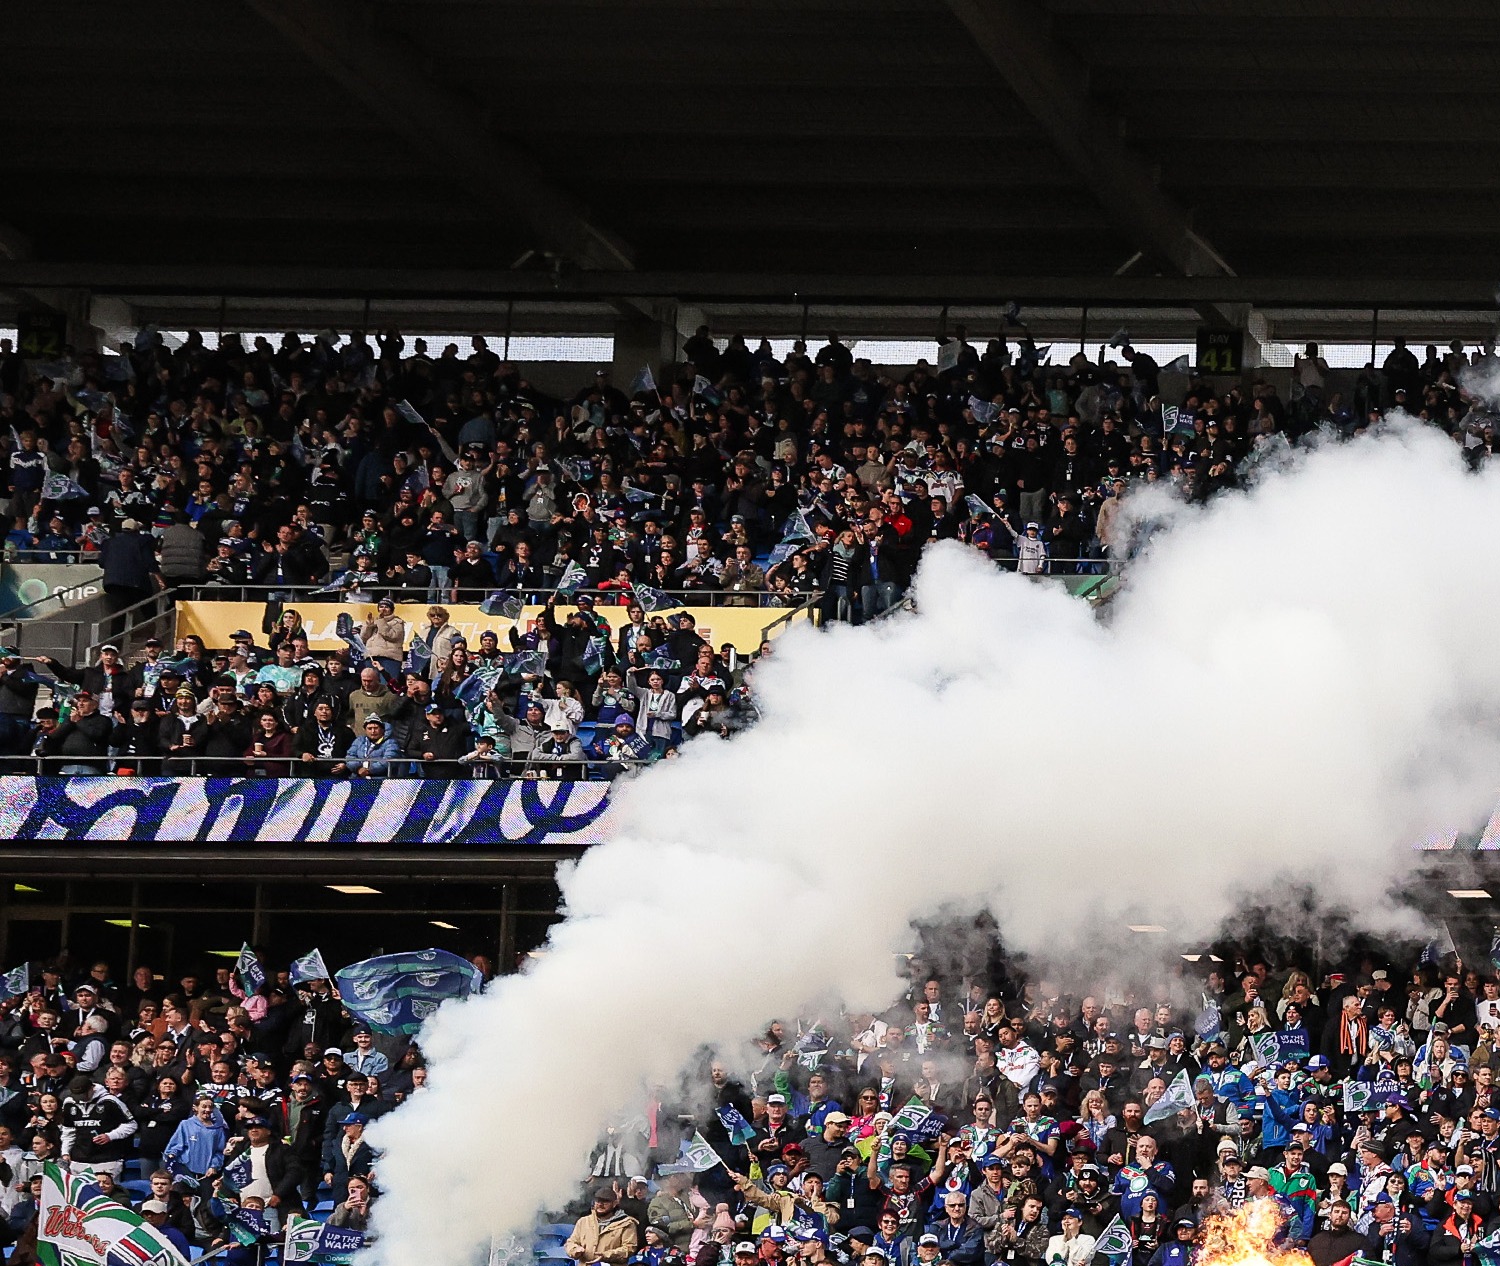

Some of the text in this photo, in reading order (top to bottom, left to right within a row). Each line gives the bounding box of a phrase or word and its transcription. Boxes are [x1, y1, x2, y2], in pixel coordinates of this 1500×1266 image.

[1209, 334, 1229, 343] BAY
[1200, 348, 1236, 372] 41
[326, 1233, 361, 1244] UP THE
[325, 1240, 358, 1250] WAHS
